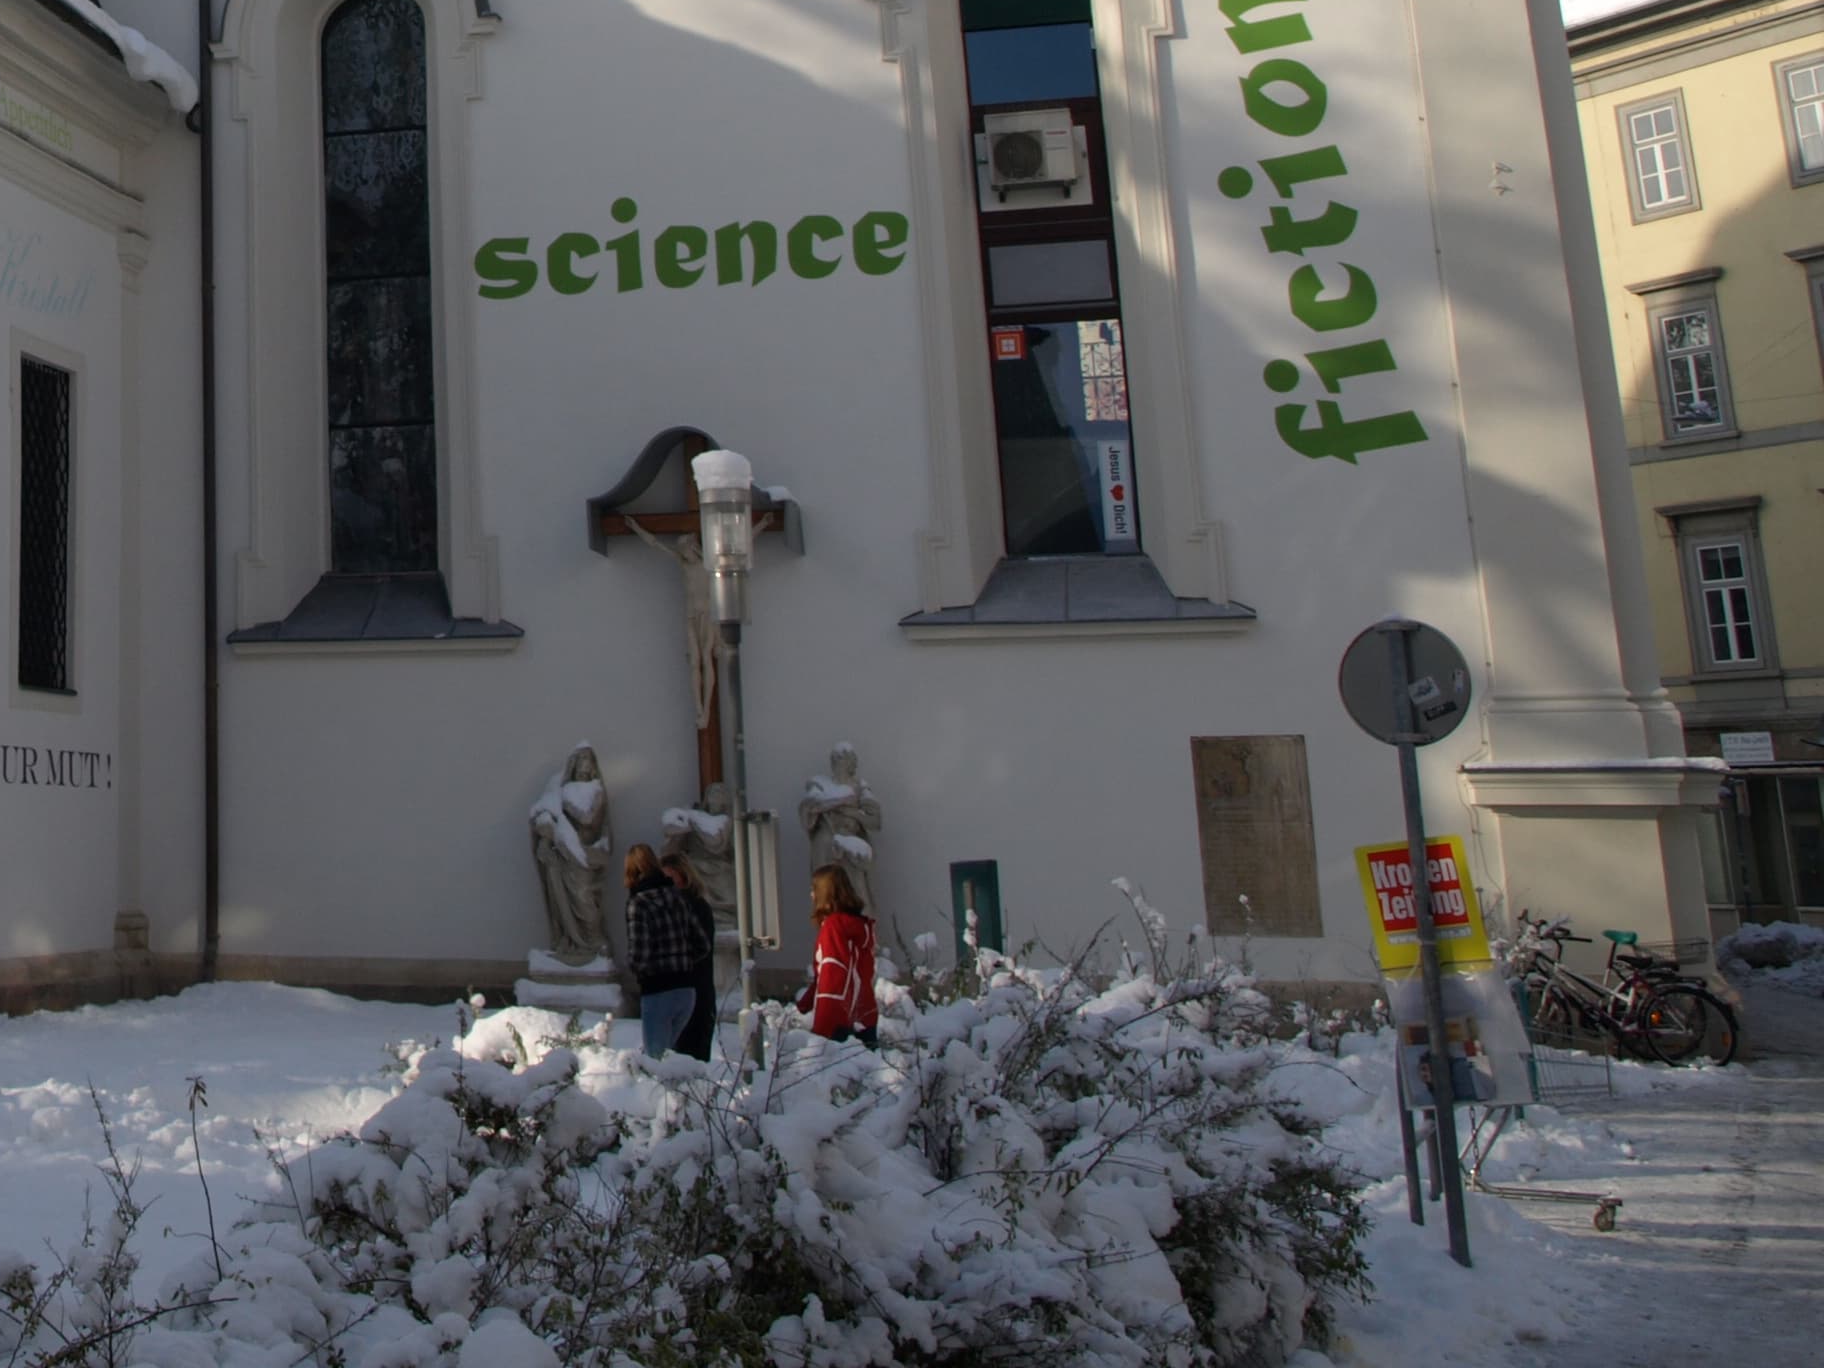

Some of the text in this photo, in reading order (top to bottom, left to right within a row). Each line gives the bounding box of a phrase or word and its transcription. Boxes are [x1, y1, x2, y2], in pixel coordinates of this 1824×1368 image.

[474, 197, 909, 300] science
[1108, 446, 1128, 534] Jesus Dich!
[1370, 857, 1458, 889] Kroen
[1378, 888, 1466, 921] Zeing
